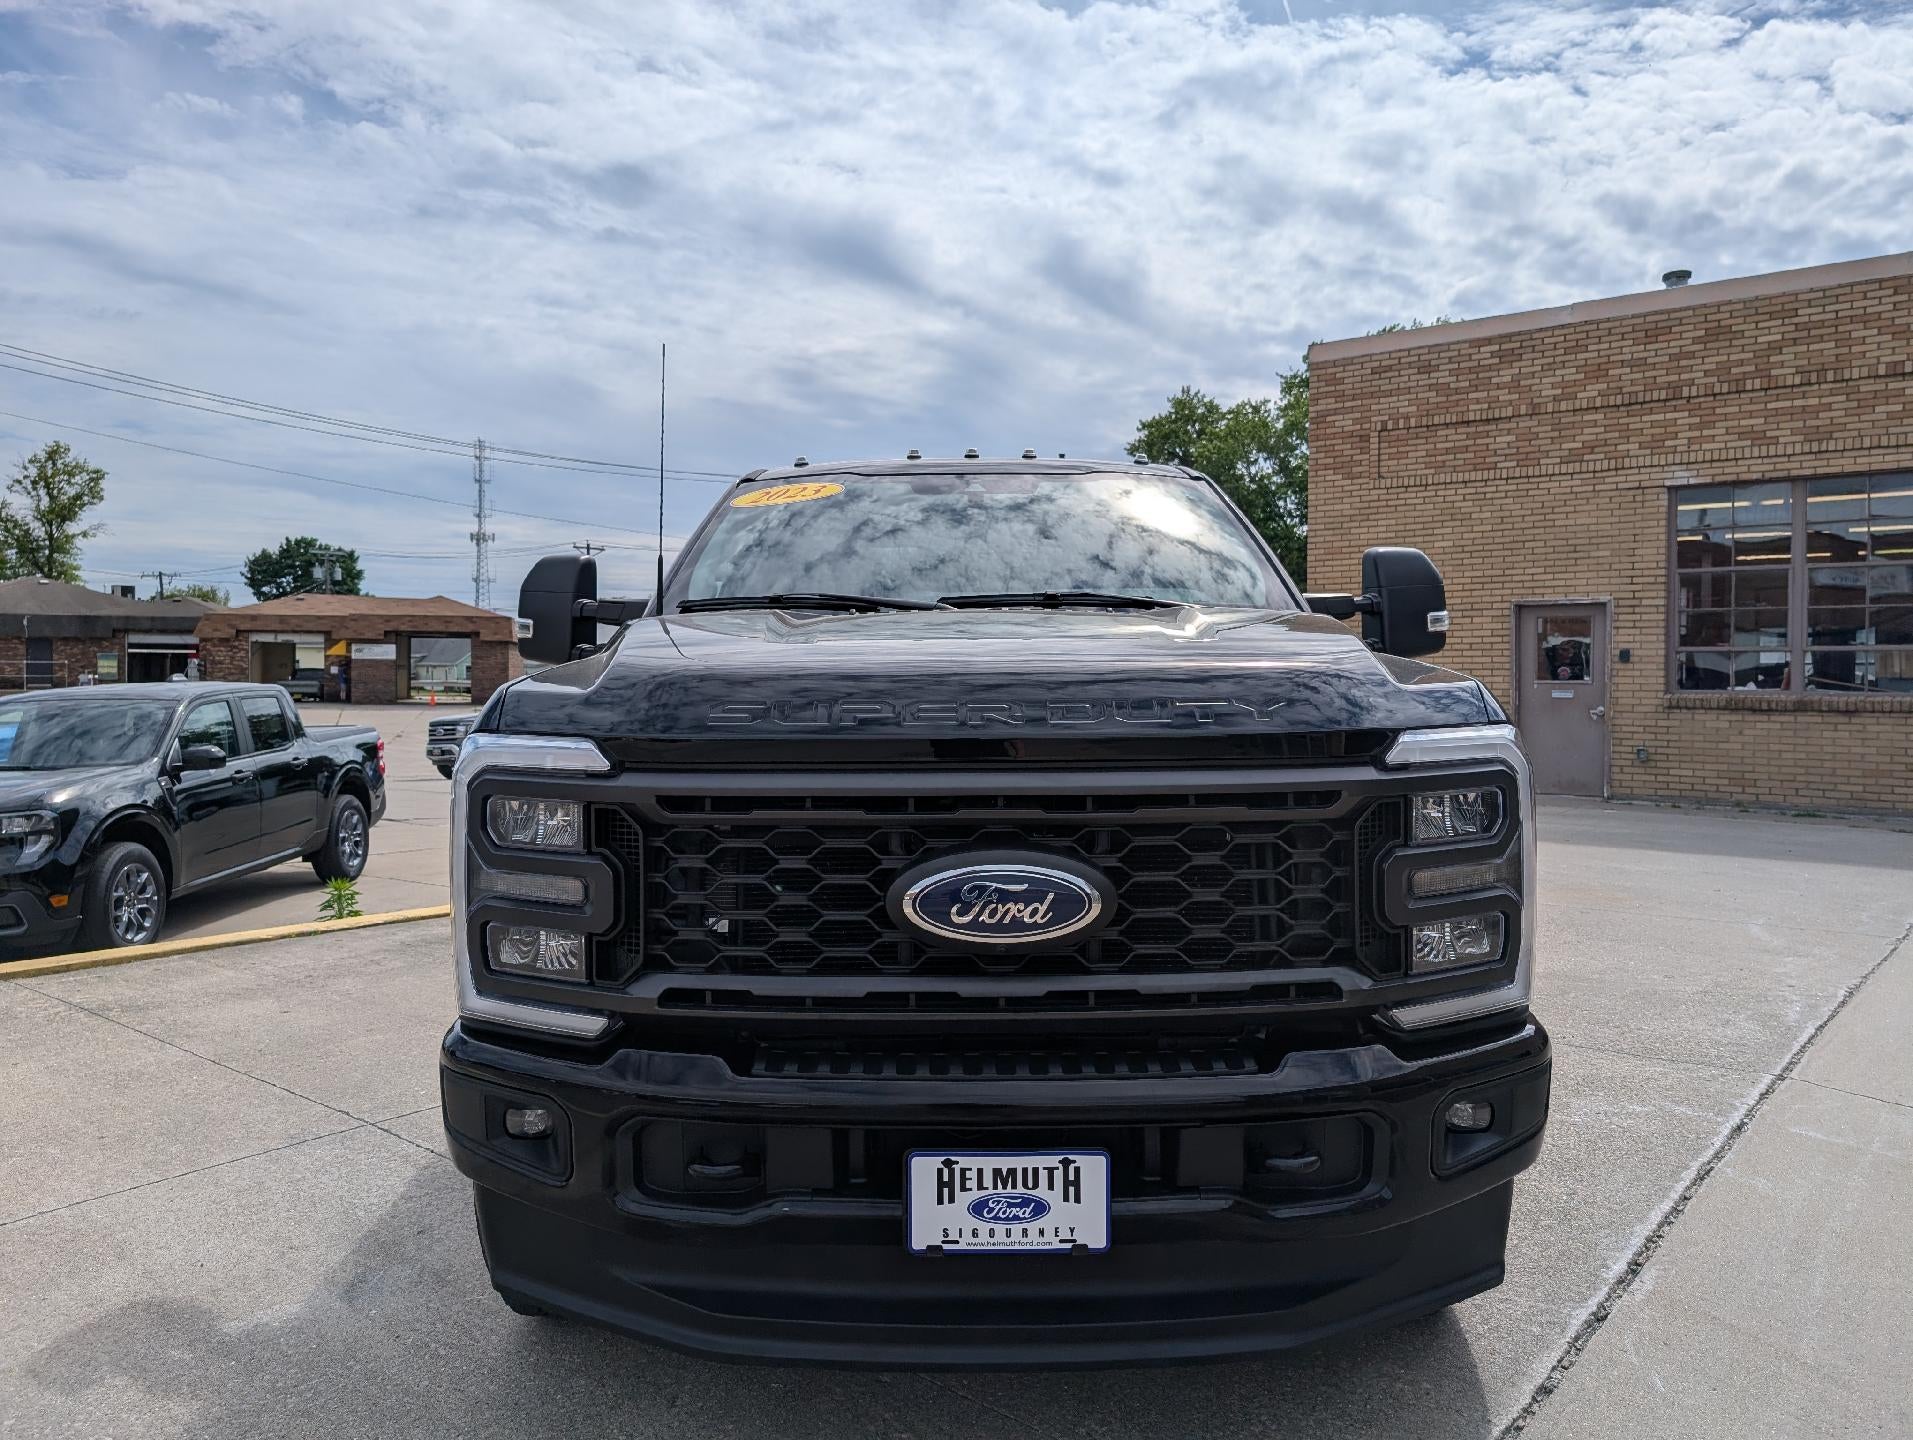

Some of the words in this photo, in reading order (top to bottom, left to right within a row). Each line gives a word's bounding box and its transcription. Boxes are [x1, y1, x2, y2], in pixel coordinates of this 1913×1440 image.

[747, 485, 828, 505] 2023
[707, 699, 1025, 727] SUPER
[1047, 697, 1289, 724] DUTY
[950, 881, 1055, 924] Ford
[936, 1159, 1082, 1206] HELMUTH
[982, 1197, 1035, 1219] Ford
[941, 1226, 1077, 1239] SIGOURNEY
[965, 1239, 1053, 1248] www.helmuthford.com
